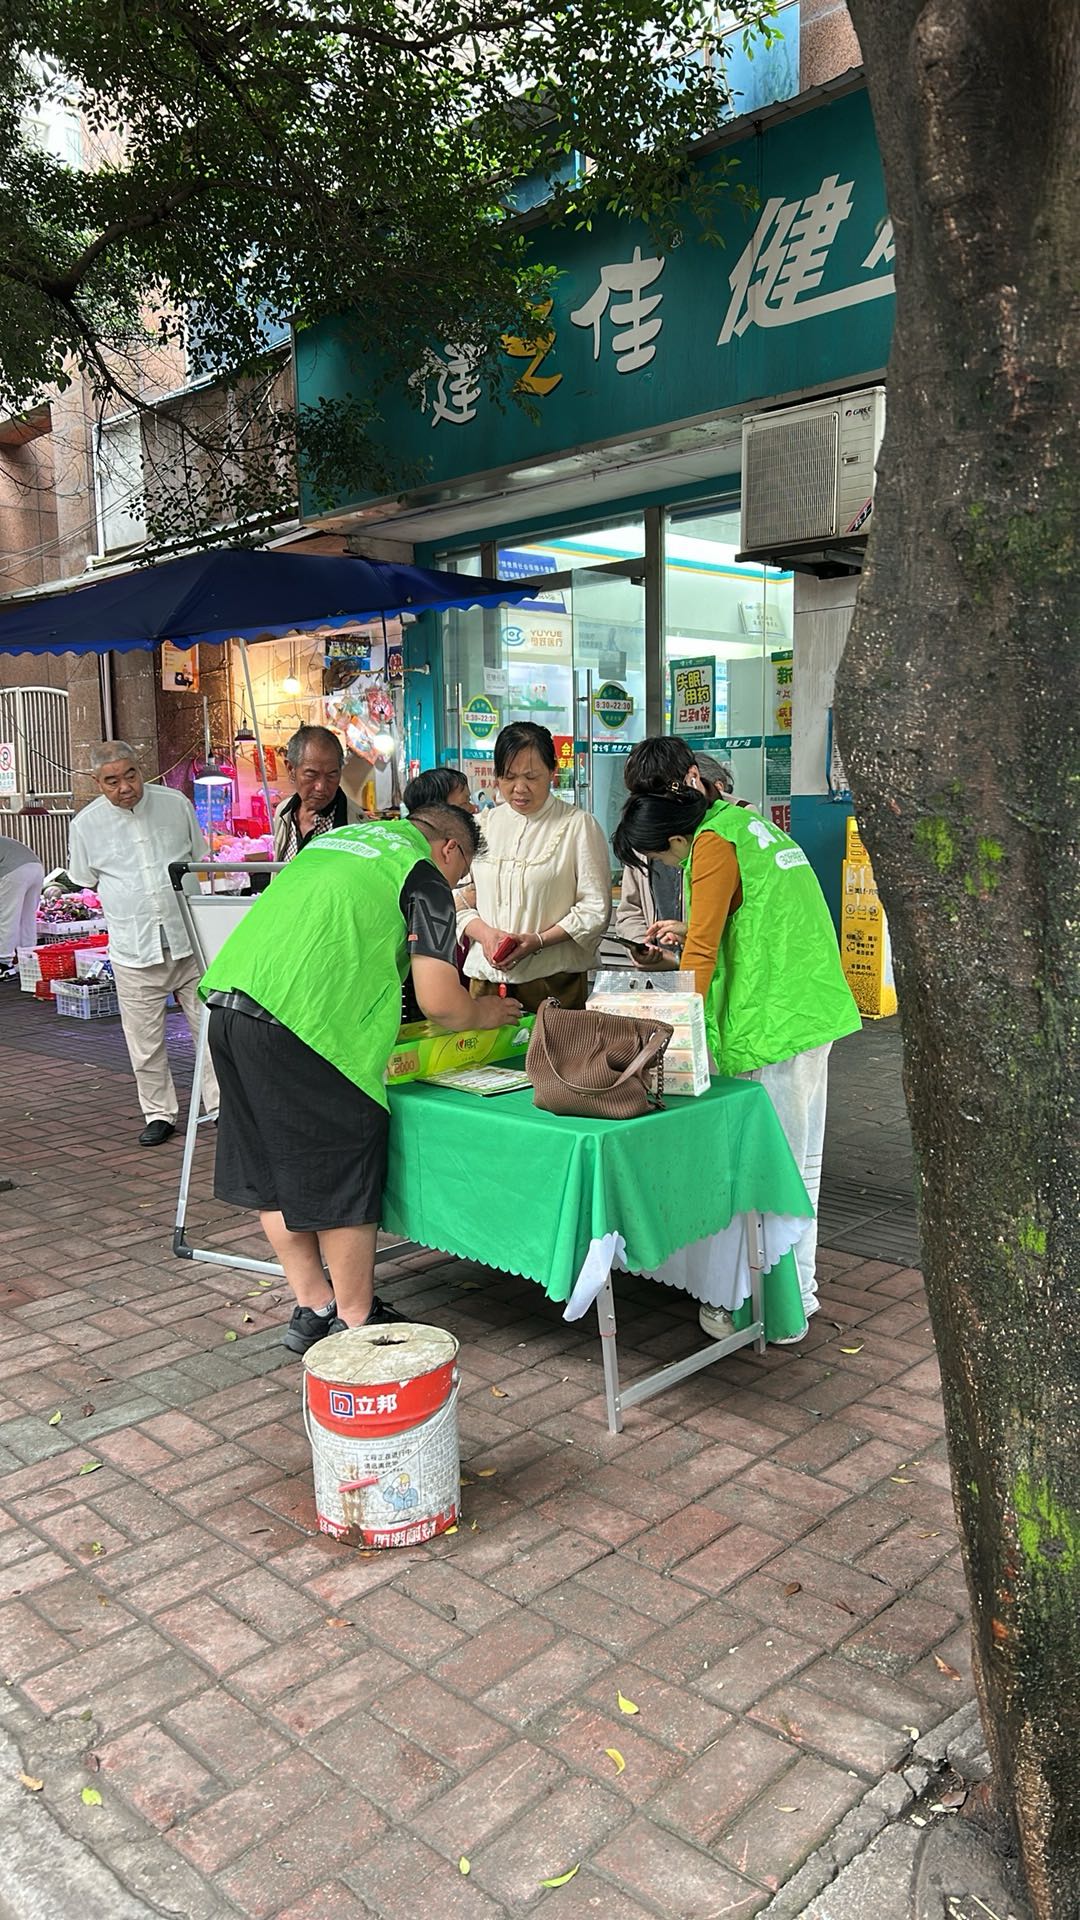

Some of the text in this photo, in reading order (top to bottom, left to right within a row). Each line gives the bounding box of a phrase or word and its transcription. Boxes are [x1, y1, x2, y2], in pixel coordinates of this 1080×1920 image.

[853, 405, 873, 416] GREE
[677, 669, 702, 691] 失眠
[684, 684, 711, 706] 用药
[597, 703, 631, 712] 8:30-22:30
[679, 706, 711, 723] 已到货
[394, 1060, 415, 1074] 2000
[356, 1393, 397, 1414] 立邦
